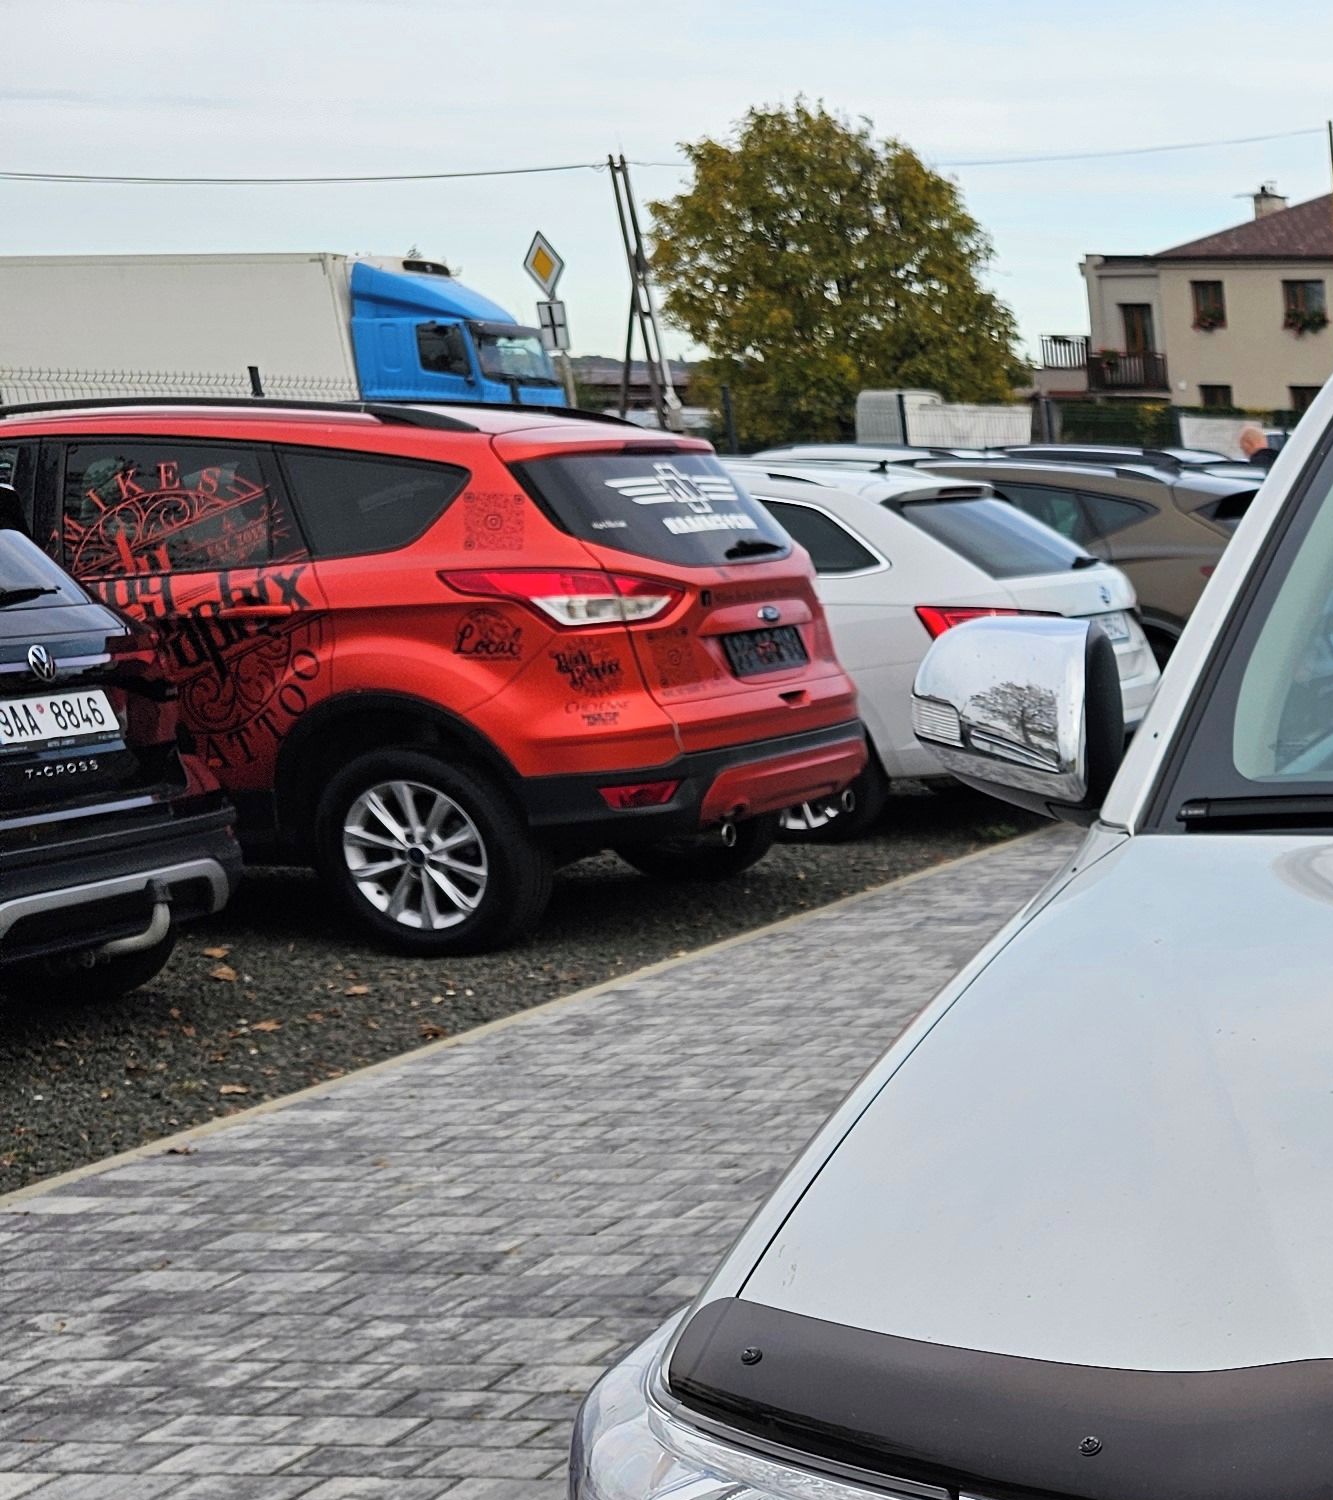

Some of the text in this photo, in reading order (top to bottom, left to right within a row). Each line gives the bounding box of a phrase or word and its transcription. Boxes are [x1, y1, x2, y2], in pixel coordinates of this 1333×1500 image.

[49, 696, 106, 731] 8846
[203, 649, 320, 770] ATTOO
[24, 759, 100, 780] T-CROSS
